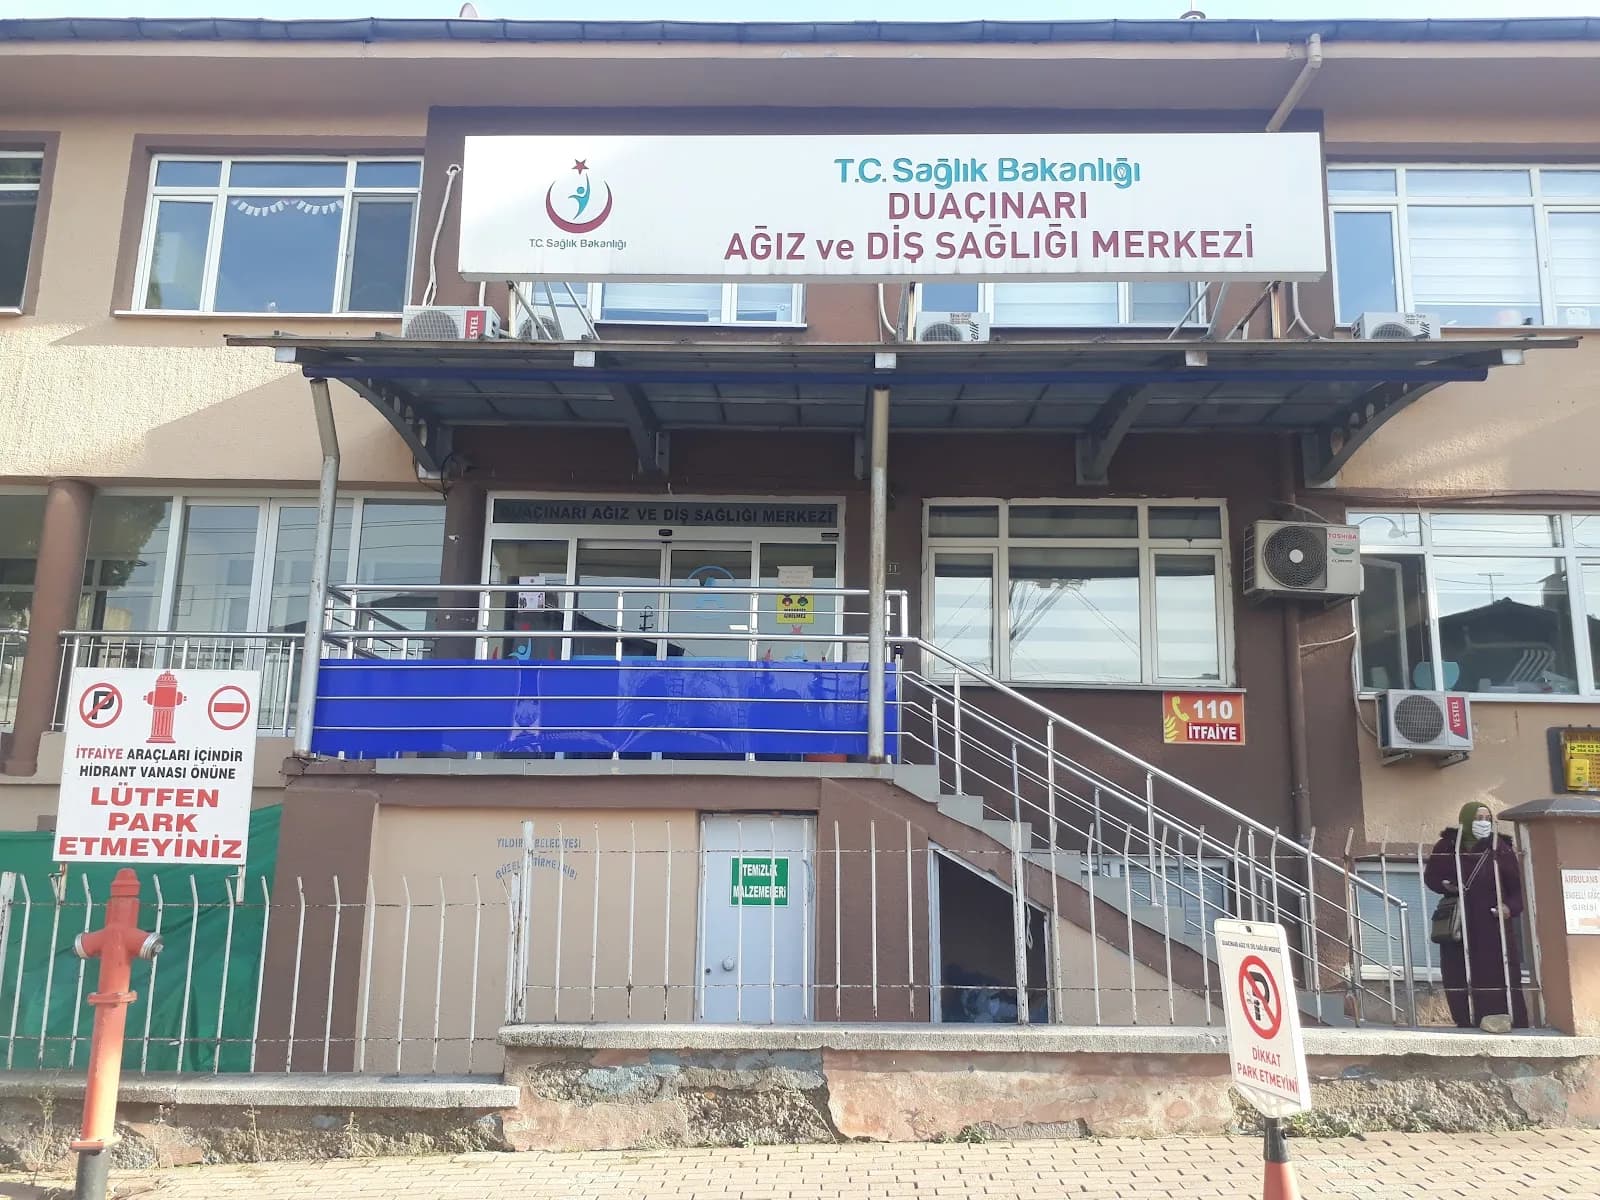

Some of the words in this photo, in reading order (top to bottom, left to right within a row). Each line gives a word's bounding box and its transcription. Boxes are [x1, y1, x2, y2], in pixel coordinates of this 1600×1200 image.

[892, 157, 988, 190] Sağlık
[998, 157, 1141, 189] Bakanlığı
[889, 192, 1087, 223] DUAÇINARI
[546, 239, 577, 249] Sağlık
[580, 239, 627, 250] Bakanlığı
[724, 225, 805, 260] AĞIZ
[816, 239, 855, 260] ve
[867, 225, 924, 263] DİŞ
[935, 224, 1078, 260] SAĞLIĞI
[1092, 224, 1253, 259] MERKEZİ
[592, 505, 629, 520] AĞIZ
[638, 508, 656, 520] VE
[664, 506, 688, 523] DİŞ
[694, 507, 757, 521] SAĞLIĞI
[763, 509, 832, 523] MERKEZİ
[1193, 699, 1233, 719] 110
[1452, 700, 1461, 727] VESTEL
[1188, 723, 1237, 740] İTFAİYE
[76, 745, 124, 760] İTFAİYE
[127, 749, 189, 763] ARAÇLARI
[194, 747, 243, 764] İÇİNDİR
[80, 762, 136, 777] HİDRANT
[141, 766, 186, 778] VANASI
[190, 764, 236, 779] ÖNÜNE
[91, 782, 219, 807] LÜTFEN
[108, 812, 198, 832] PARK
[58, 834, 242, 858] ETMEYİNİZ
[1252, 1045, 1280, 1067] DİKKAT
[1237, 1062, 1258, 1080] PARK
